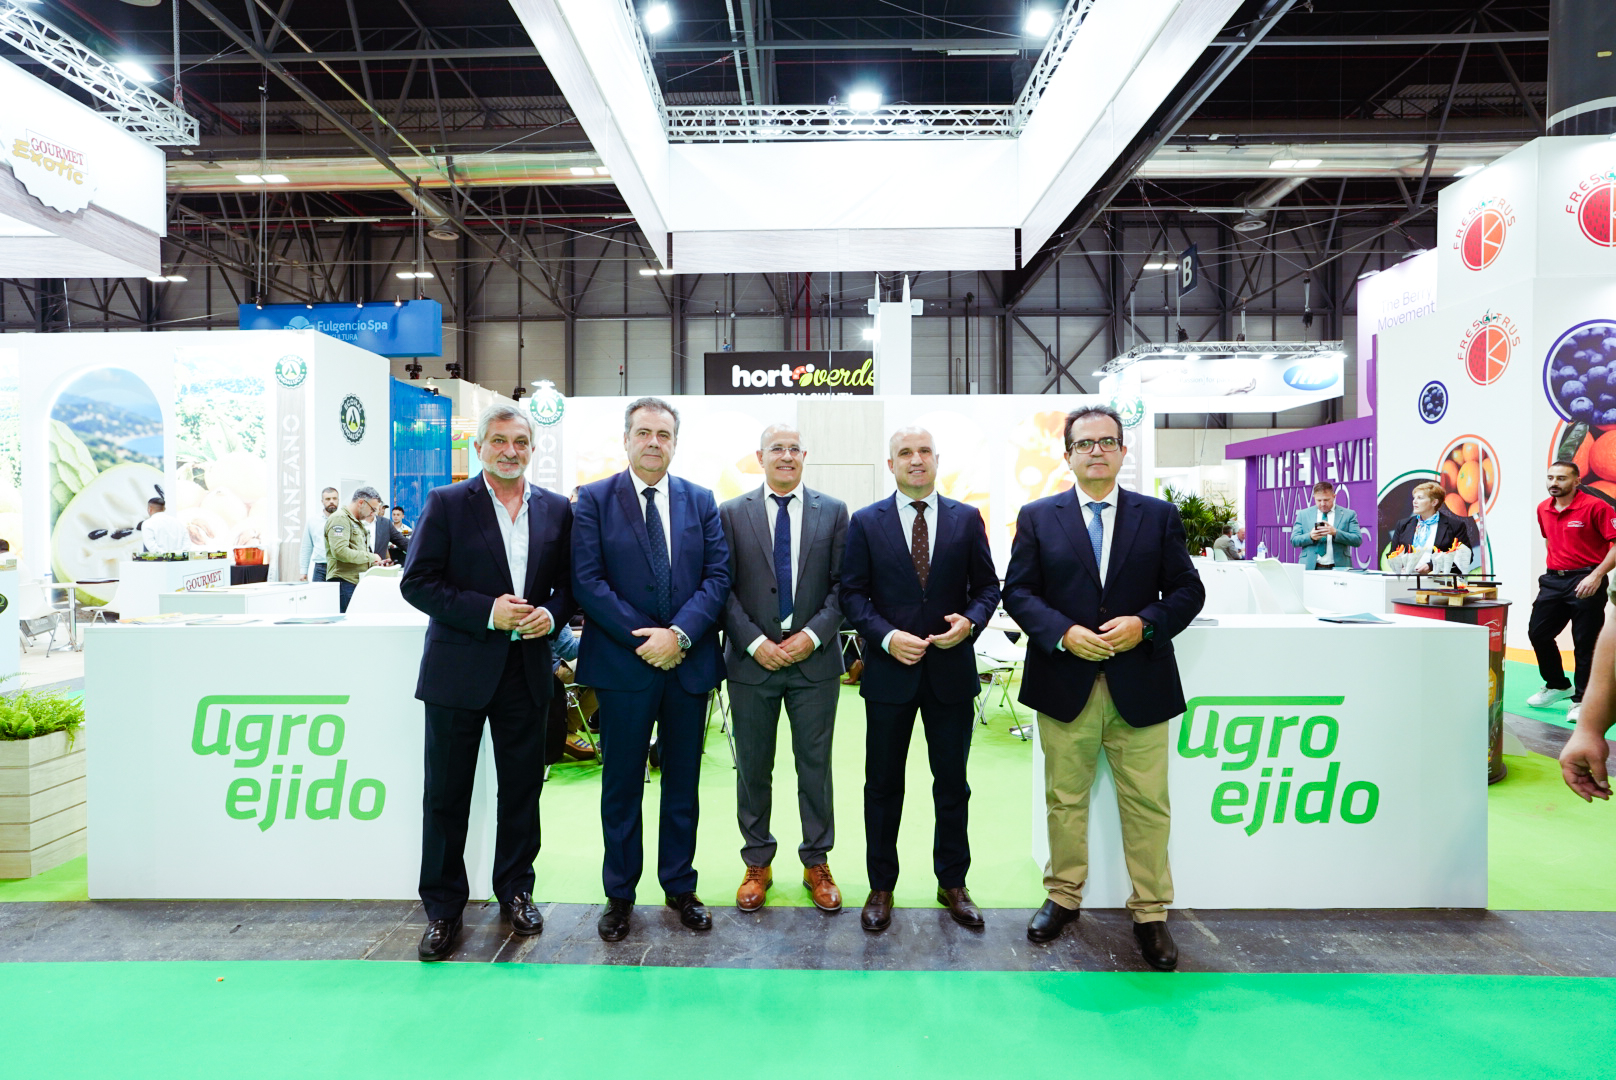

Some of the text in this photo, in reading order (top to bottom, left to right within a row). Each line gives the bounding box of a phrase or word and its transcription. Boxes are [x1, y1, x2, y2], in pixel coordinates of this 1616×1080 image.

[31, 137, 84, 166] GOURMET
[1182, 255, 1193, 289] B
[1402, 286, 1433, 306] Berry
[317, 319, 388, 334] Fulgencio Spa
[1378, 300, 1436, 332] Movement
[282, 414, 301, 543] MANZANO
[1271, 438, 1360, 489] THE NEW
[185, 570, 222, 591] GOURMET
[225, 759, 386, 833] ejido
[1211, 761, 1380, 837] ejido
